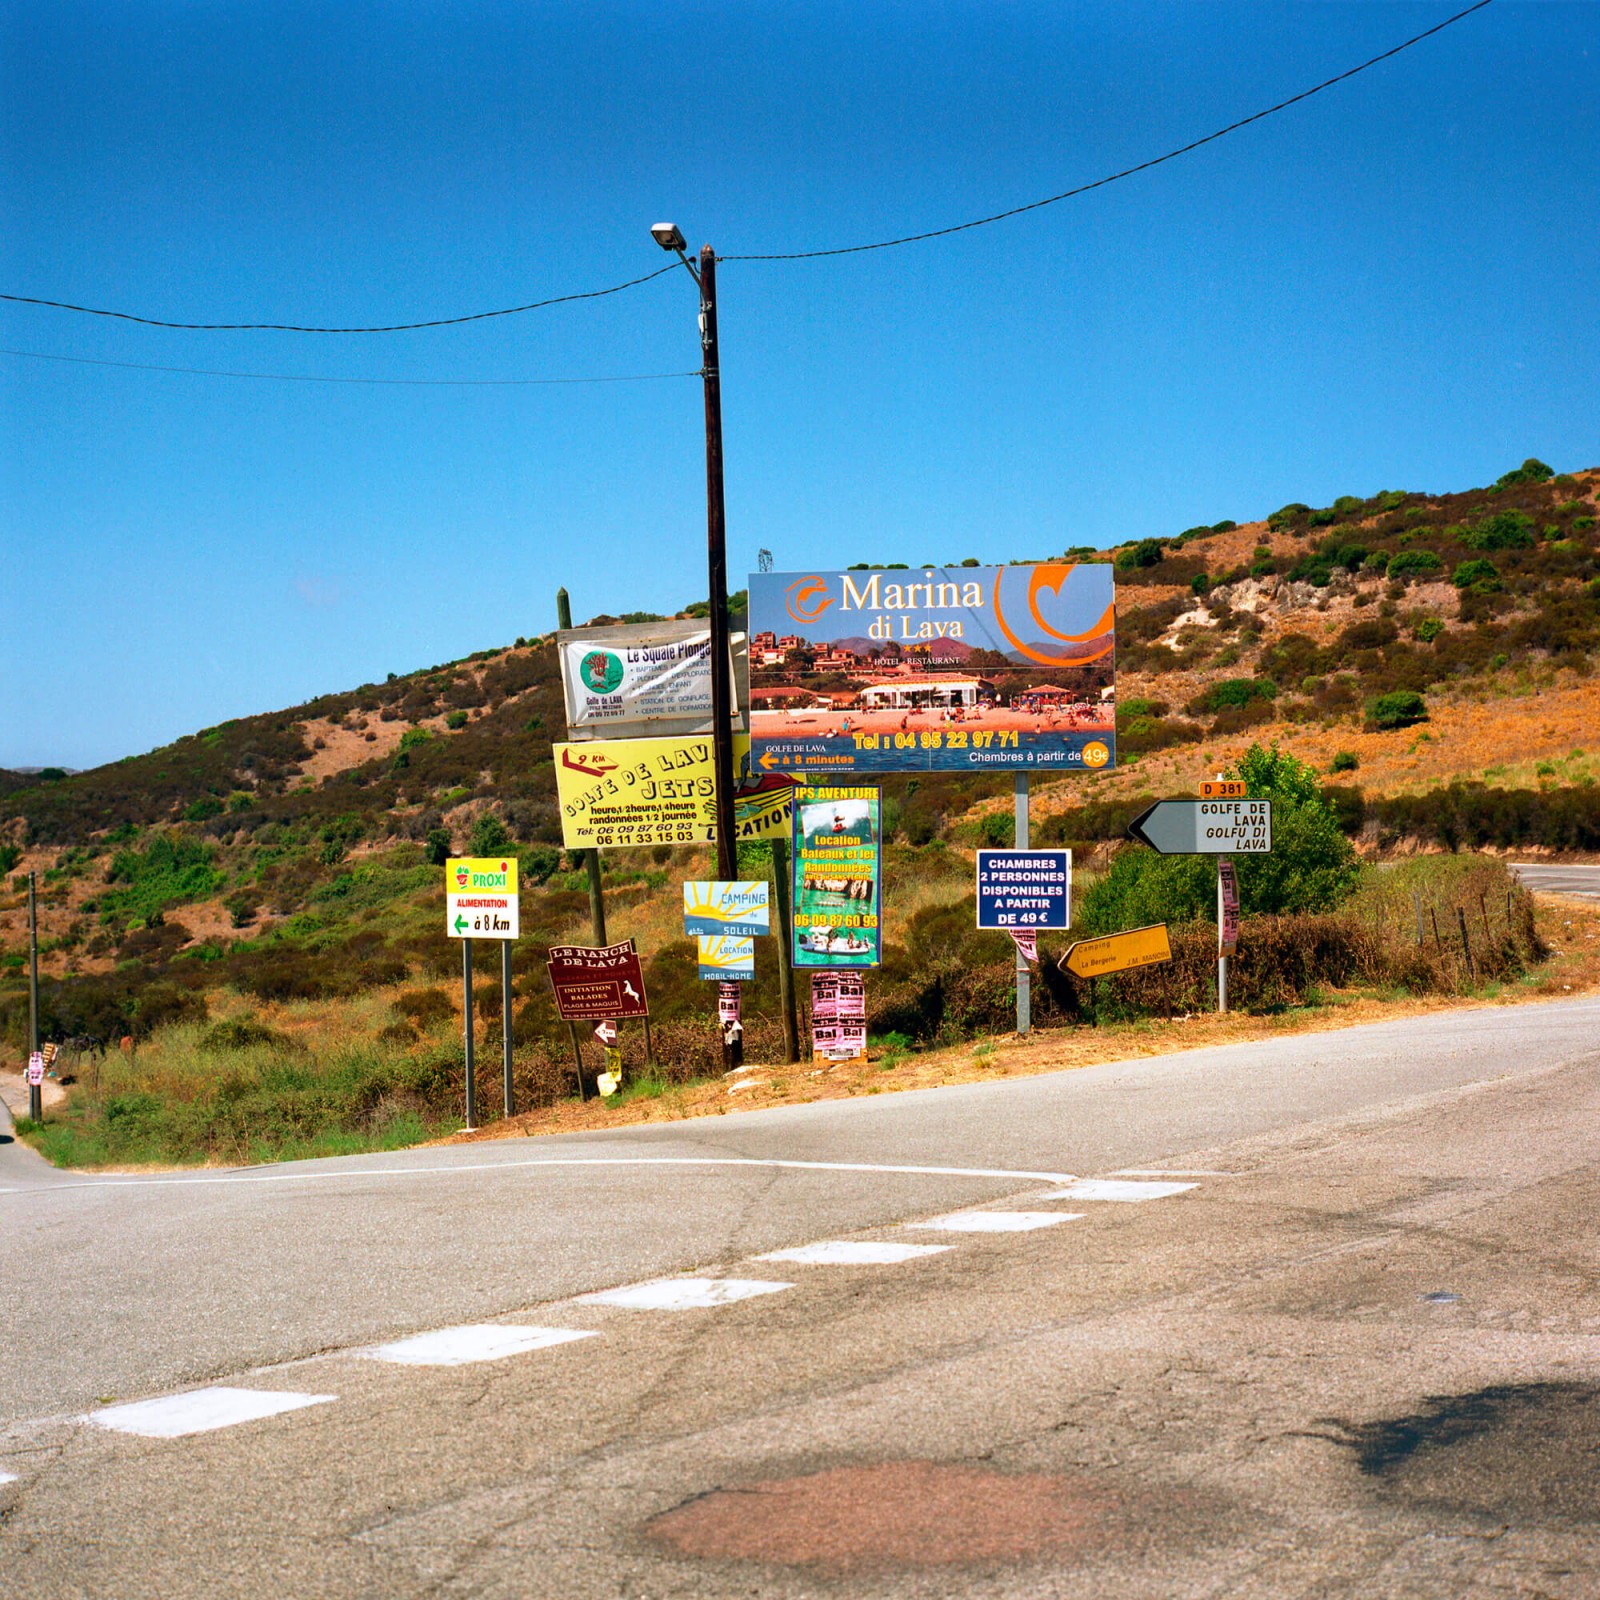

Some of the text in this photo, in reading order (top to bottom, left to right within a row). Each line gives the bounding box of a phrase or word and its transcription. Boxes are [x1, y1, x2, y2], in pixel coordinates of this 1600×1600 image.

[838, 571, 984, 611] Marina
[868, 615, 963, 639] di Lava
[627, 646, 639, 663] Le
[642, 643, 675, 664] Squale
[874, 656, 960, 665] HÔTEL RESTAURANT
[852, 733, 879, 749] Tel
[895, 732, 916, 749] 04
[920, 732, 942, 748] 95
[946, 731, 968, 748] 22
[972, 731, 994, 748] 97
[998, 731, 1019, 747] 71
[578, 754, 587, 764] 9
[783, 755, 855, 764] à 8 minutes
[969, 748, 1108, 764] Chambres à partir de 49€
[564, 743, 716, 817] GOLFE DE LAV
[640, 776, 715, 801] JETS
[794, 787, 879, 800] JPS AVENTURE
[1205, 784, 1241, 794] D 381
[1201, 803, 1266, 814] GOLFE DE
[589, 814, 643, 825] randonnées
[662, 811, 697, 822] journée
[707, 801, 792, 840] LCATION
[1235, 816, 1266, 826] LAVA
[597, 826, 614, 835] 06
[617, 825, 634, 833] 09
[637, 824, 653, 833] 87
[656, 823, 673, 831] 60
[676, 822, 693, 830] 93
[1206, 827, 1266, 838] GOLFU DI
[597, 831, 694, 845] 06 11 33 15 03
[815, 835, 861, 846] Location
[1236, 839, 1266, 849] LAVA
[801, 848, 875, 860] Bateaux et Jet
[804, 862, 872, 873] Randonnées
[988, 859, 1057, 869] CHAMBRES
[473, 872, 506, 887] PROXI
[980, 872, 1065, 881] 2 PERSONNES
[982, 886, 1063, 896] DISPONIBLES
[457, 899, 508, 908] ALIMENTATION
[721, 894, 766, 905] CAMPING
[994, 899, 1050, 908] A PARTIR
[484, 914, 490, 931] 8
[493, 914, 510, 931] km
[794, 914, 878, 928] 06 09 87 60 93
[998, 914, 1016, 924] DE
[1019, 912, 1037, 923] 49
[724, 927, 759, 935] SOLEIL
[552, 944, 629, 958] LE RANCH
[1078, 941, 1111, 953] Camping
[562, 956, 628, 968] DE LAVA
[564, 985, 611, 993] INITIATION
[817, 990, 836, 999] Bal
[840, 986, 863, 995] Bal
[721, 1001, 738, 1010] Bal
[815, 1029, 837, 1039] Bal
[843, 1027, 862, 1036] Bal
